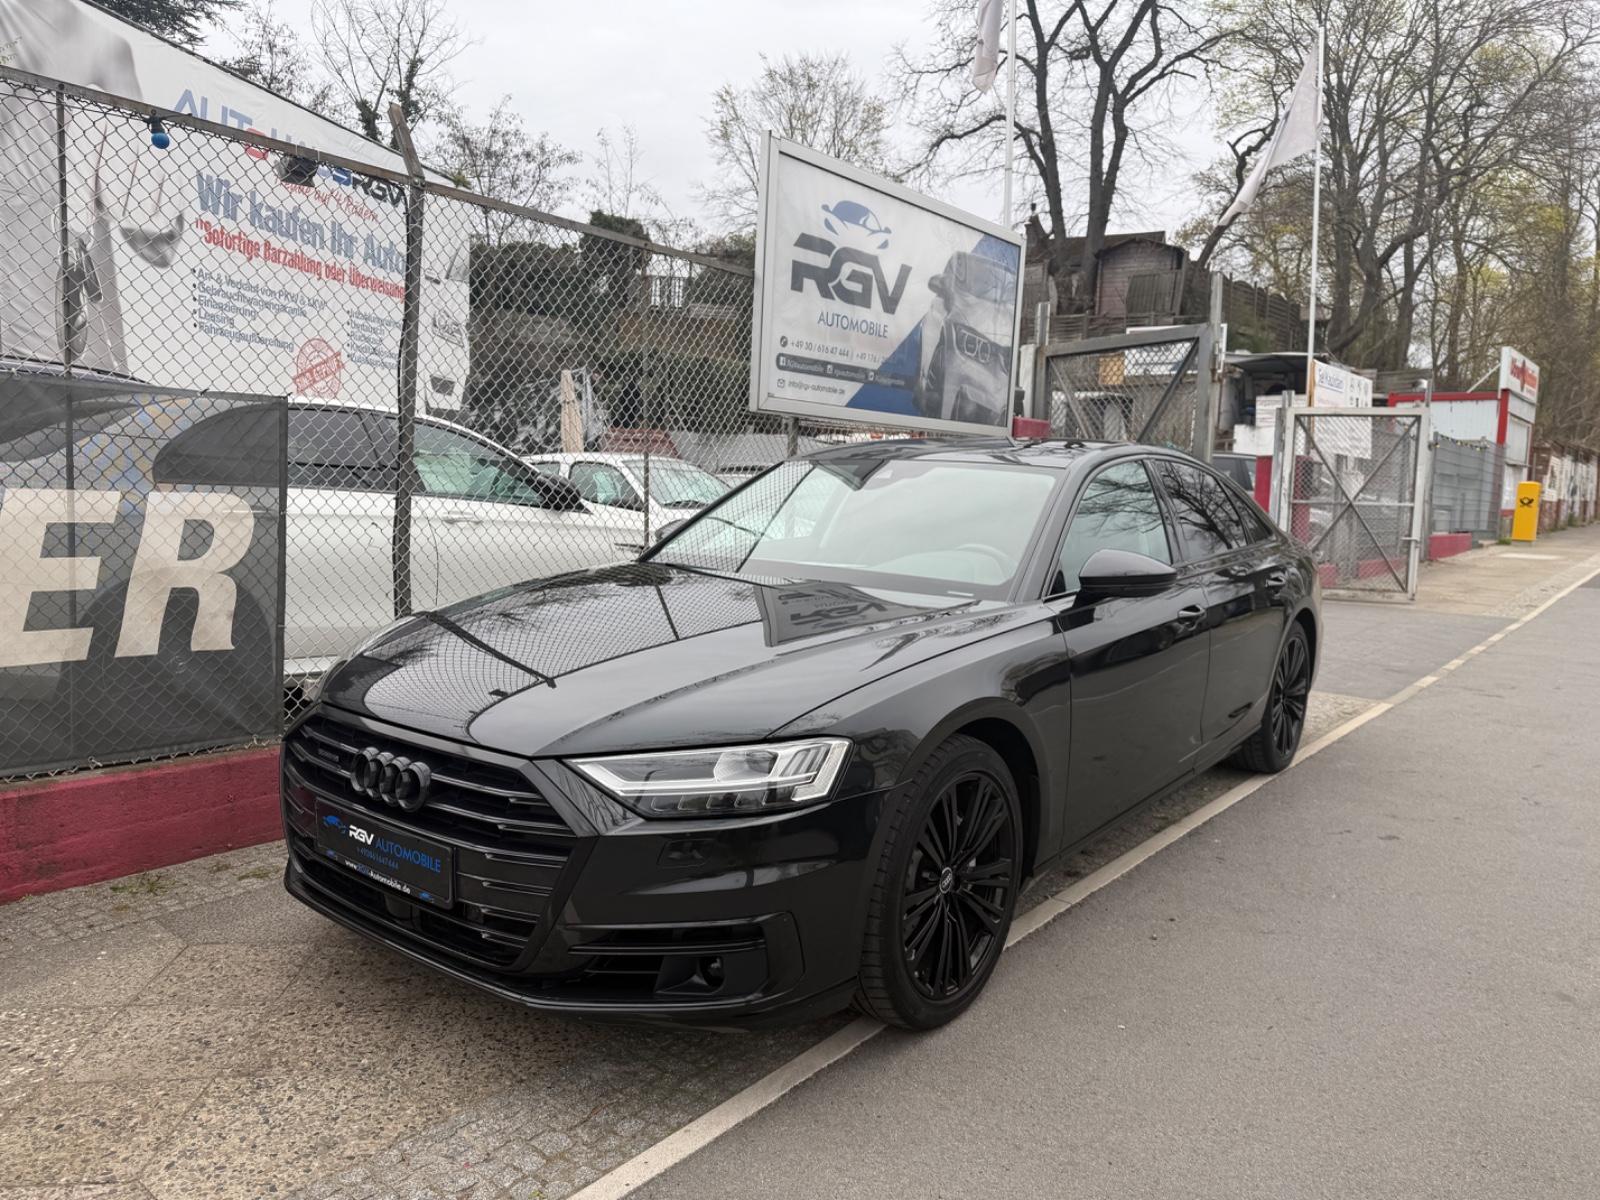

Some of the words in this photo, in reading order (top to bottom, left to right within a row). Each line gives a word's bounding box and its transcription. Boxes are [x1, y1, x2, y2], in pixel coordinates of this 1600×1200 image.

[196, 169, 243, 221] Wir
[249, 190, 325, 251] kaufen
[330, 219, 360, 259] Ihr
[362, 232, 406, 275] Auto
[263, 240, 323, 281] Barzahlung
[324, 260, 346, 285] oder
[790, 232, 913, 315] RGV
[817, 310, 889, 340] AUTOMOBILE
[348, 824, 375, 846] RGV
[375, 837, 441, 873] AUTOMOBILE
